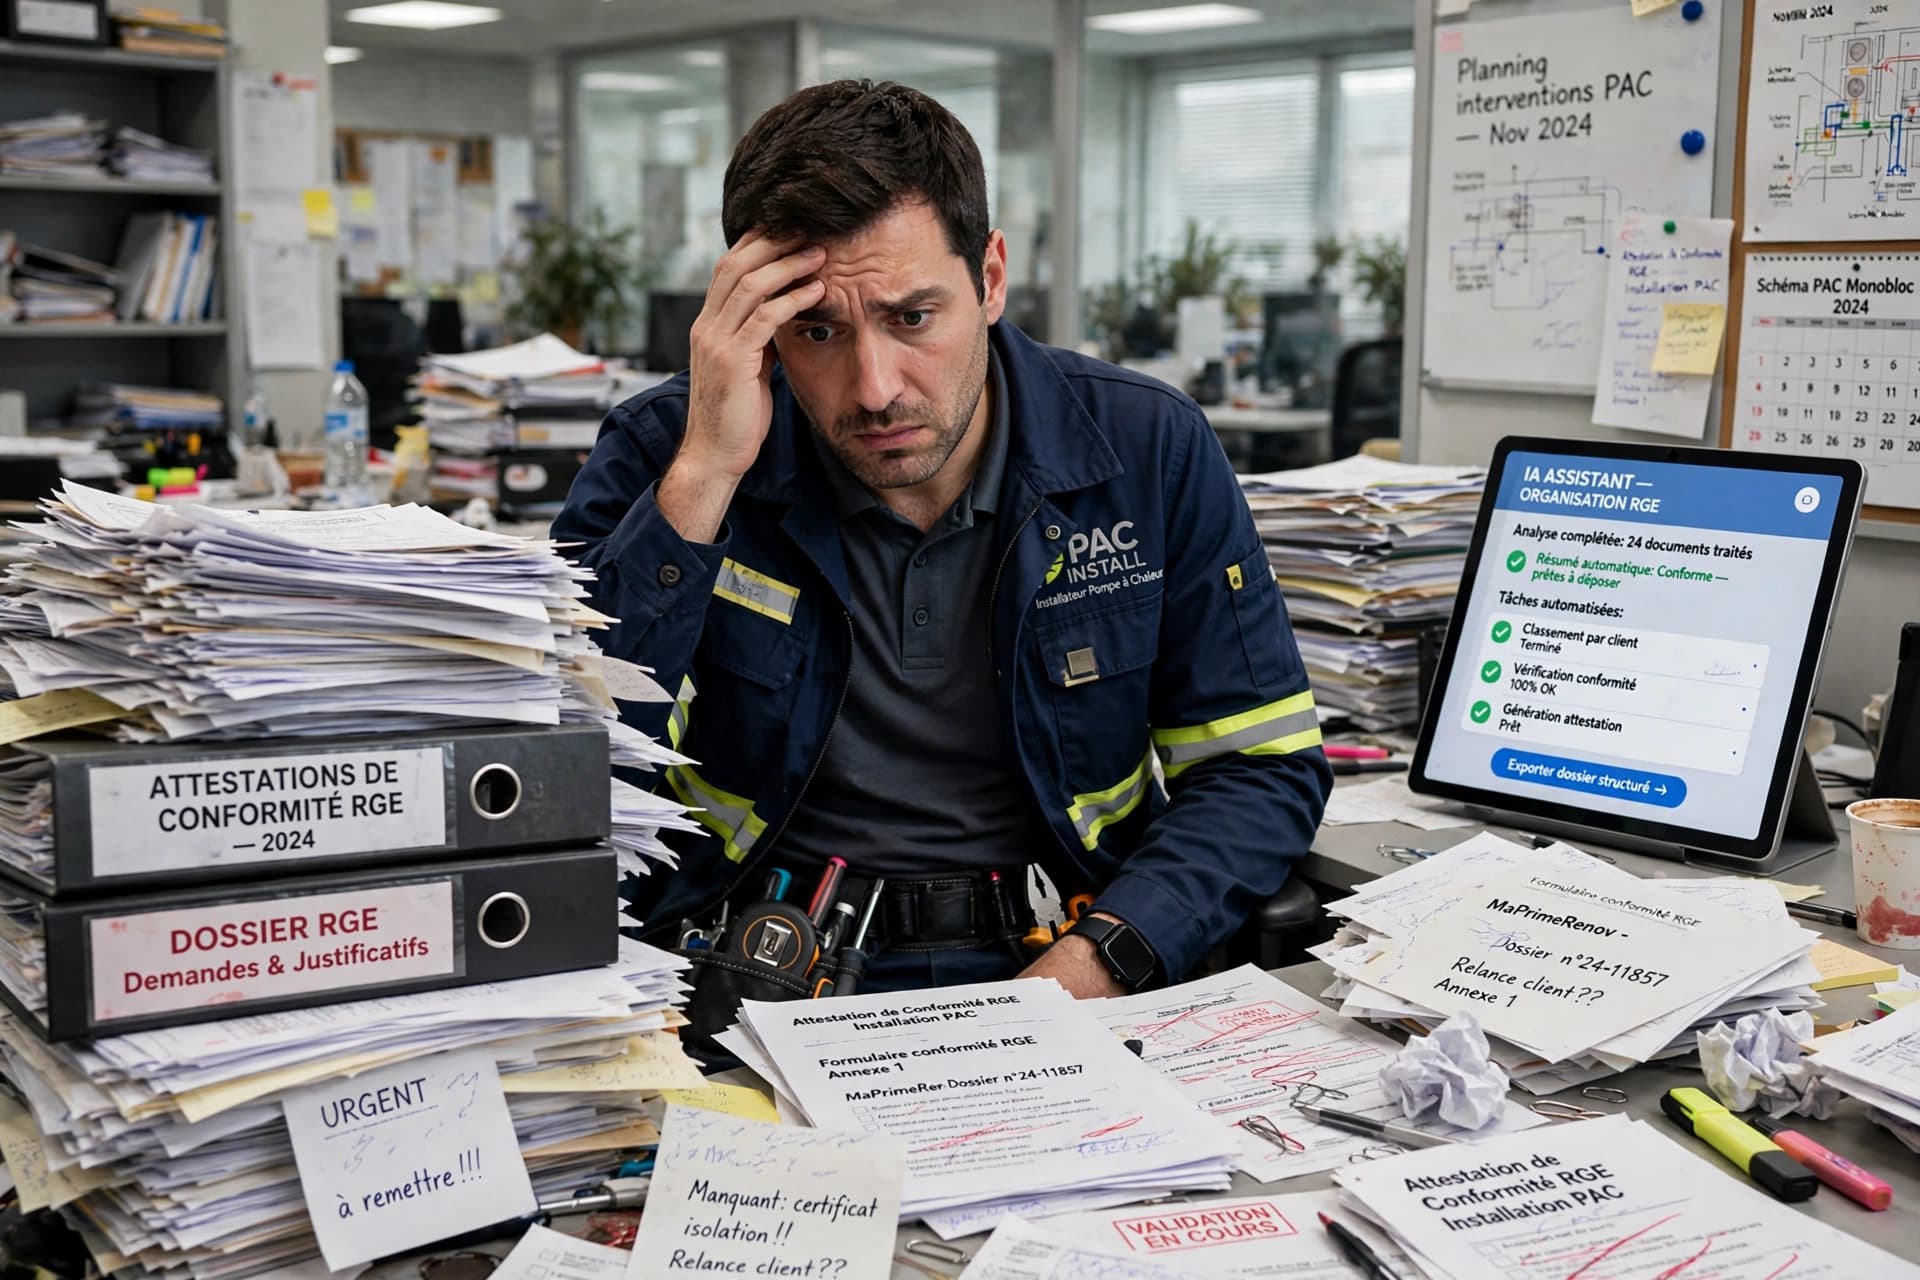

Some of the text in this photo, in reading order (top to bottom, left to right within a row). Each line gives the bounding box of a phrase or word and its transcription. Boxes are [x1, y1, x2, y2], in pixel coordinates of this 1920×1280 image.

[1457, 53, 1548, 83] Planning
[1457, 70, 1654, 115] interventions PAC
[1489, 121, 1530, 145] Nov
[1538, 112, 1592, 140] 2024
[1694, 279, 1721, 292] PAC
[1757, 277, 1914, 294] Schéma PAC Monobloc
[1833, 299, 1869, 315] 2024
[1784, 356, 1790, 367] 2
[1863, 358, 1870, 369] 5
[1890, 359, 1897, 370] 6
[1858, 385, 1871, 396] 12
[1886, 386, 1897, 397] 11
[1855, 410, 1868, 423] 23
[1882, 412, 1896, 424] 22
[1523, 465, 1540, 483] IA
[1543, 467, 1635, 490] ASSISTANT
[1519, 487, 1661, 513] ORGANISATION RGE
[1067, 520, 1139, 564] PAC
[1513, 523, 1753, 560] Analyse complétée: 24 documents traités
[1067, 551, 1147, 584] INSTALL
[1531, 568, 1621, 589] prêtes à déposer
[1536, 552, 1579, 568] Résumé
[1581, 558, 1654, 577] automatique:
[1657, 565, 1713, 582] Conforme
[1035, 588, 1087, 609] Installateur
[1088, 579, 1120, 596] Pompe
[1122, 575, 1130, 588] à
[1499, 590, 1624, 618] Tâches automatisées:
[1521, 638, 1561, 654] Terminé
[1522, 622, 1639, 649] Classement par client
[1510, 678, 1558, 695] 100% OK
[1514, 662, 1637, 691] Vérification conformité
[1498, 719, 1521, 733] Prêt
[1503, 703, 1622, 733] Génération attestation
[150, 761, 399, 800] ATTESTATIONS DE
[1507, 758, 1650, 794] Exporter dossier structuré
[158, 790, 404, 832] CONFORMITÉ RGE
[262, 829, 316, 852] 2024
[170, 907, 379, 955] DOSSIER RGE
[1486, 898, 1617, 938] MaPrimeRenov
[124, 936, 429, 994] Demandes & Justificatifs
[1451, 956, 1517, 986] Relance
[1490, 936, 1669, 988] Dossier n°24-11857
[1434, 977, 1518, 1009] Annexe 1
[793, 995, 1021, 1027] Attestation de Conformité RGE
[853, 1009, 978, 1031] Installation PAC
[819, 1034, 1038, 1069] Formulaire conformité RGE
[827, 1062, 906, 1080] Annexe 1
[947, 1074, 999, 1091] Dossier
[1003, 1064, 1084, 1084] n°24-11857
[321, 1077, 427, 1128] URGENT
[1404, 1153, 1561, 1193] Attestation de
[1421, 1163, 1615, 1212] Conformité RGE
[336, 1193, 354, 1218] à
[687, 1179, 878, 1224] Manquant: certificat
[1441, 1184, 1624, 1232] Installation PAC
[1126, 1207, 1271, 1235] VALIDATION
[1143, 1220, 1279, 1249] EN COURS
[669, 1249, 746, 1274] Relance
